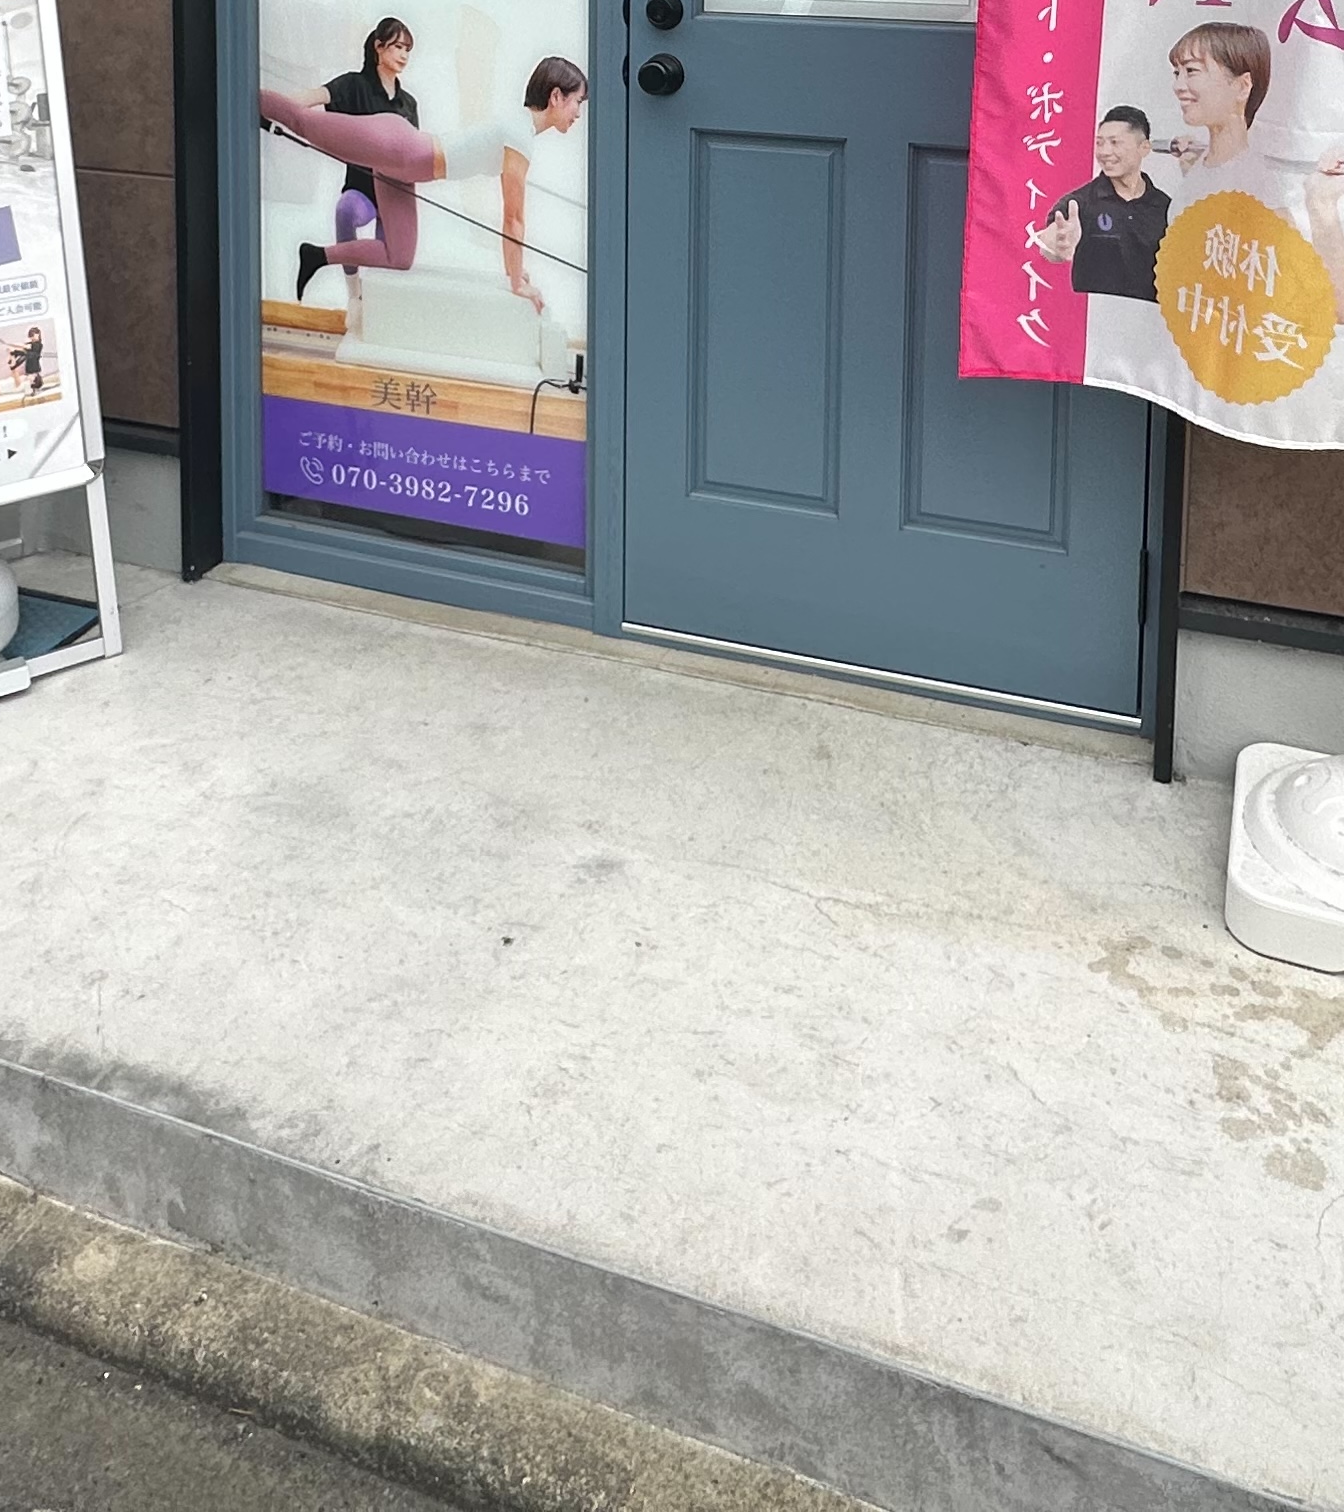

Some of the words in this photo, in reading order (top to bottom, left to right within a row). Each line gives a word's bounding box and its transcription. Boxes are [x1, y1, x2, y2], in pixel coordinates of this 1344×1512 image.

[298, 431, 551, 485] ご予約・お問い合わせはこちらまで
[332, 463, 530, 516] 070-3982-7296
